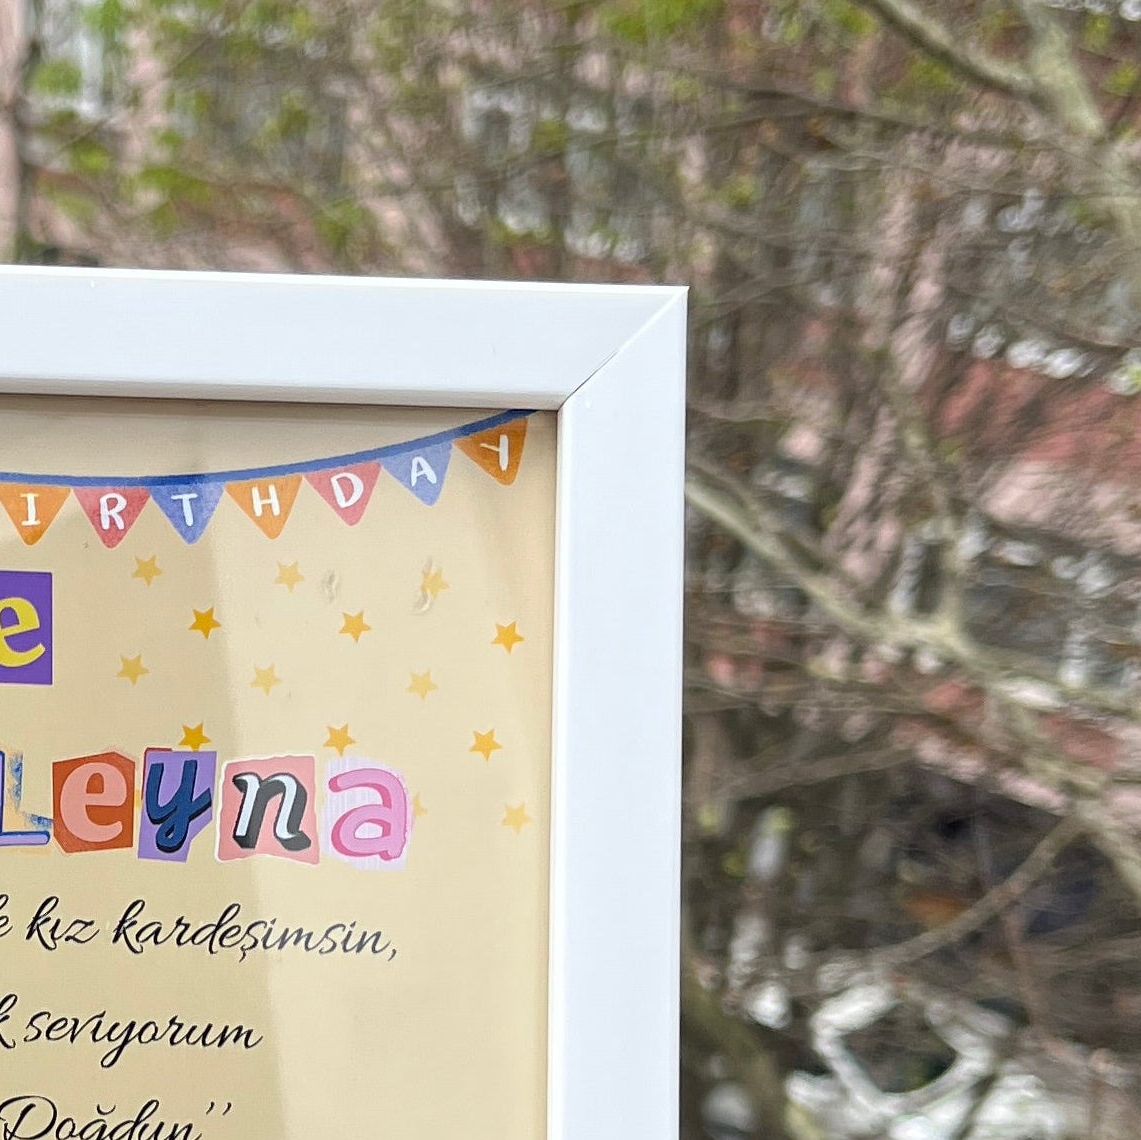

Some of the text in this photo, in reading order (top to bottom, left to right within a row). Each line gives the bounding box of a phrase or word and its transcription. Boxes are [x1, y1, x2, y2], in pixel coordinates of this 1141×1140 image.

[25, 895, 101, 952] kız
[111, 899, 398, 963] kardeşimsin,
[23, 1010, 264, 1069] seviyorum
